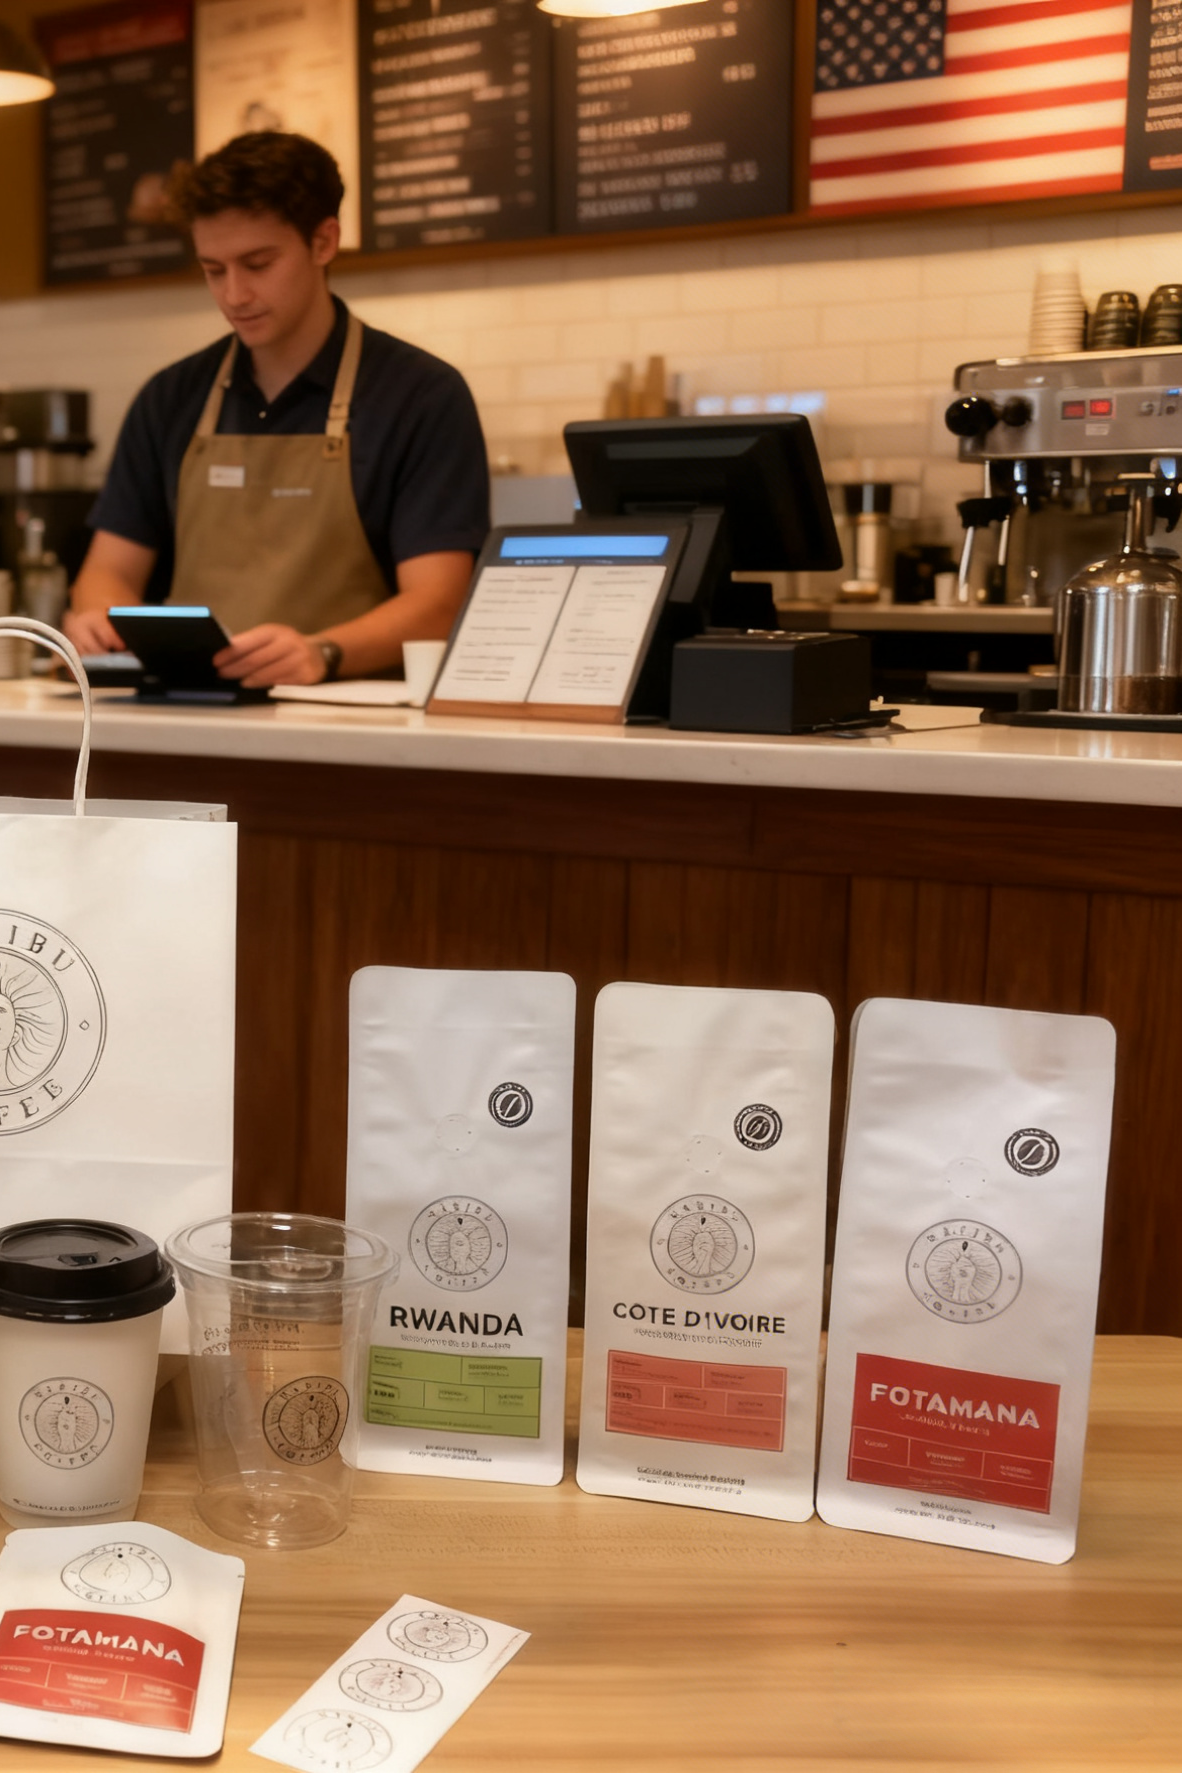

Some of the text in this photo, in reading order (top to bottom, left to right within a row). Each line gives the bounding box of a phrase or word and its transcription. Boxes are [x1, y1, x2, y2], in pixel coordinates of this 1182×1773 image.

[390, 1305, 524, 1336] RWANDA
[613, 1302, 675, 1326] COTE
[870, 1382, 1040, 1429] FOTAMANA
[13, 1624, 185, 1667] FOTAMANA
